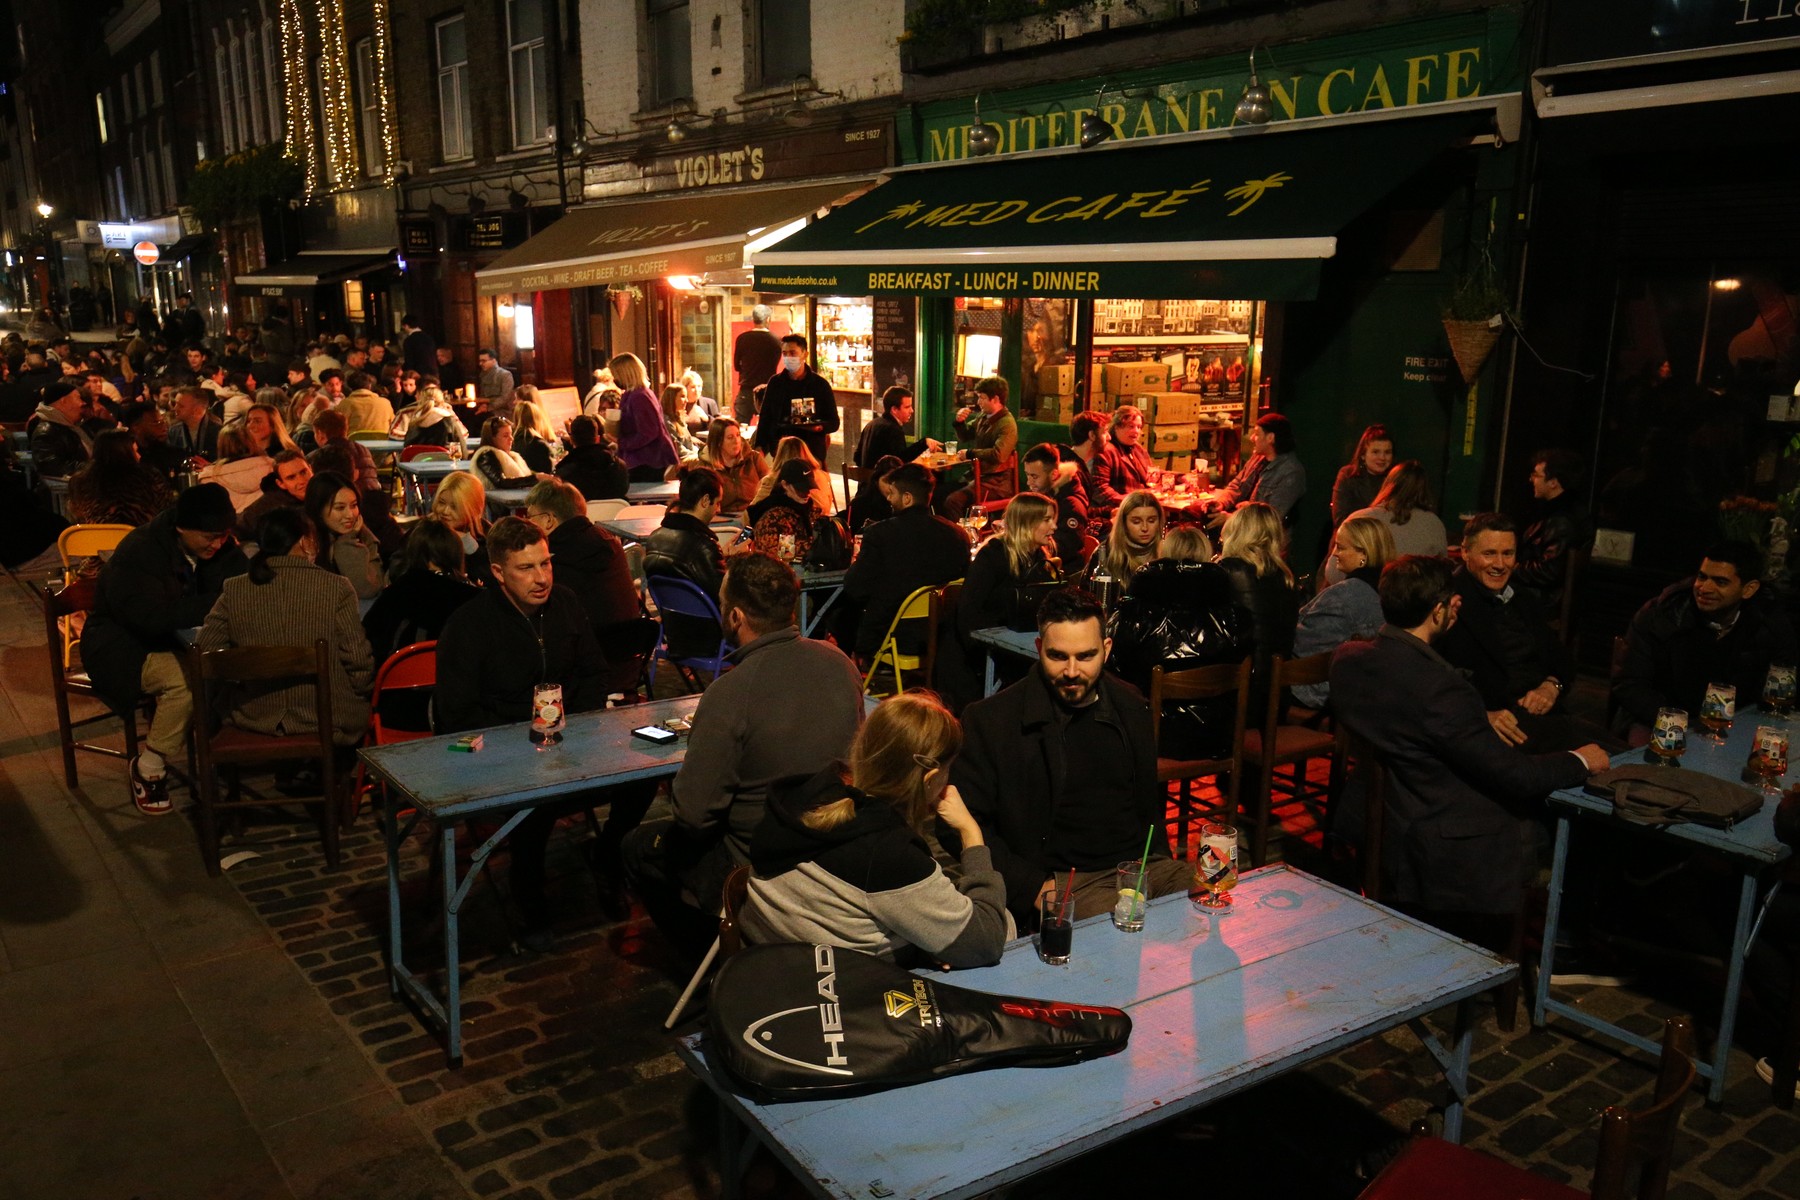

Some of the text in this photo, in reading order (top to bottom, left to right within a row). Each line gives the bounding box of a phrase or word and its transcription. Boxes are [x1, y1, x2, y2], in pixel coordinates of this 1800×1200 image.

[1317, 47, 1480, 115] CAFE
[844, 129, 881, 142] SINCE 1927
[674, 144, 765, 188] VIOLET'S
[905, 179, 1211, 229] MED CAFÉ
[587, 219, 709, 246] VIOLET'S
[705, 254, 723, 265] SINCE
[521, 274, 549, 288] COCKTAIL
[553, 272, 569, 285] WINE
[574, 269, 595, 282] DRAFT
[596, 267, 614, 280] BEER
[619, 265, 633, 277] TEA
[638, 259, 669, 275] COFFEE
[761, 275, 838, 287] www.medcafesoho.co.uk
[868, 272, 952, 290] BREAKFAST
[963, 271, 1018, 290] LUNCH
[1032, 270, 1100, 291] DINNER
[1405, 356, 1449, 368] FIRE EXIT
[1404, 371, 1425, 382] Keep
[815, 944, 848, 1066] HEAD
[912, 979, 932, 1027] TRITECH
